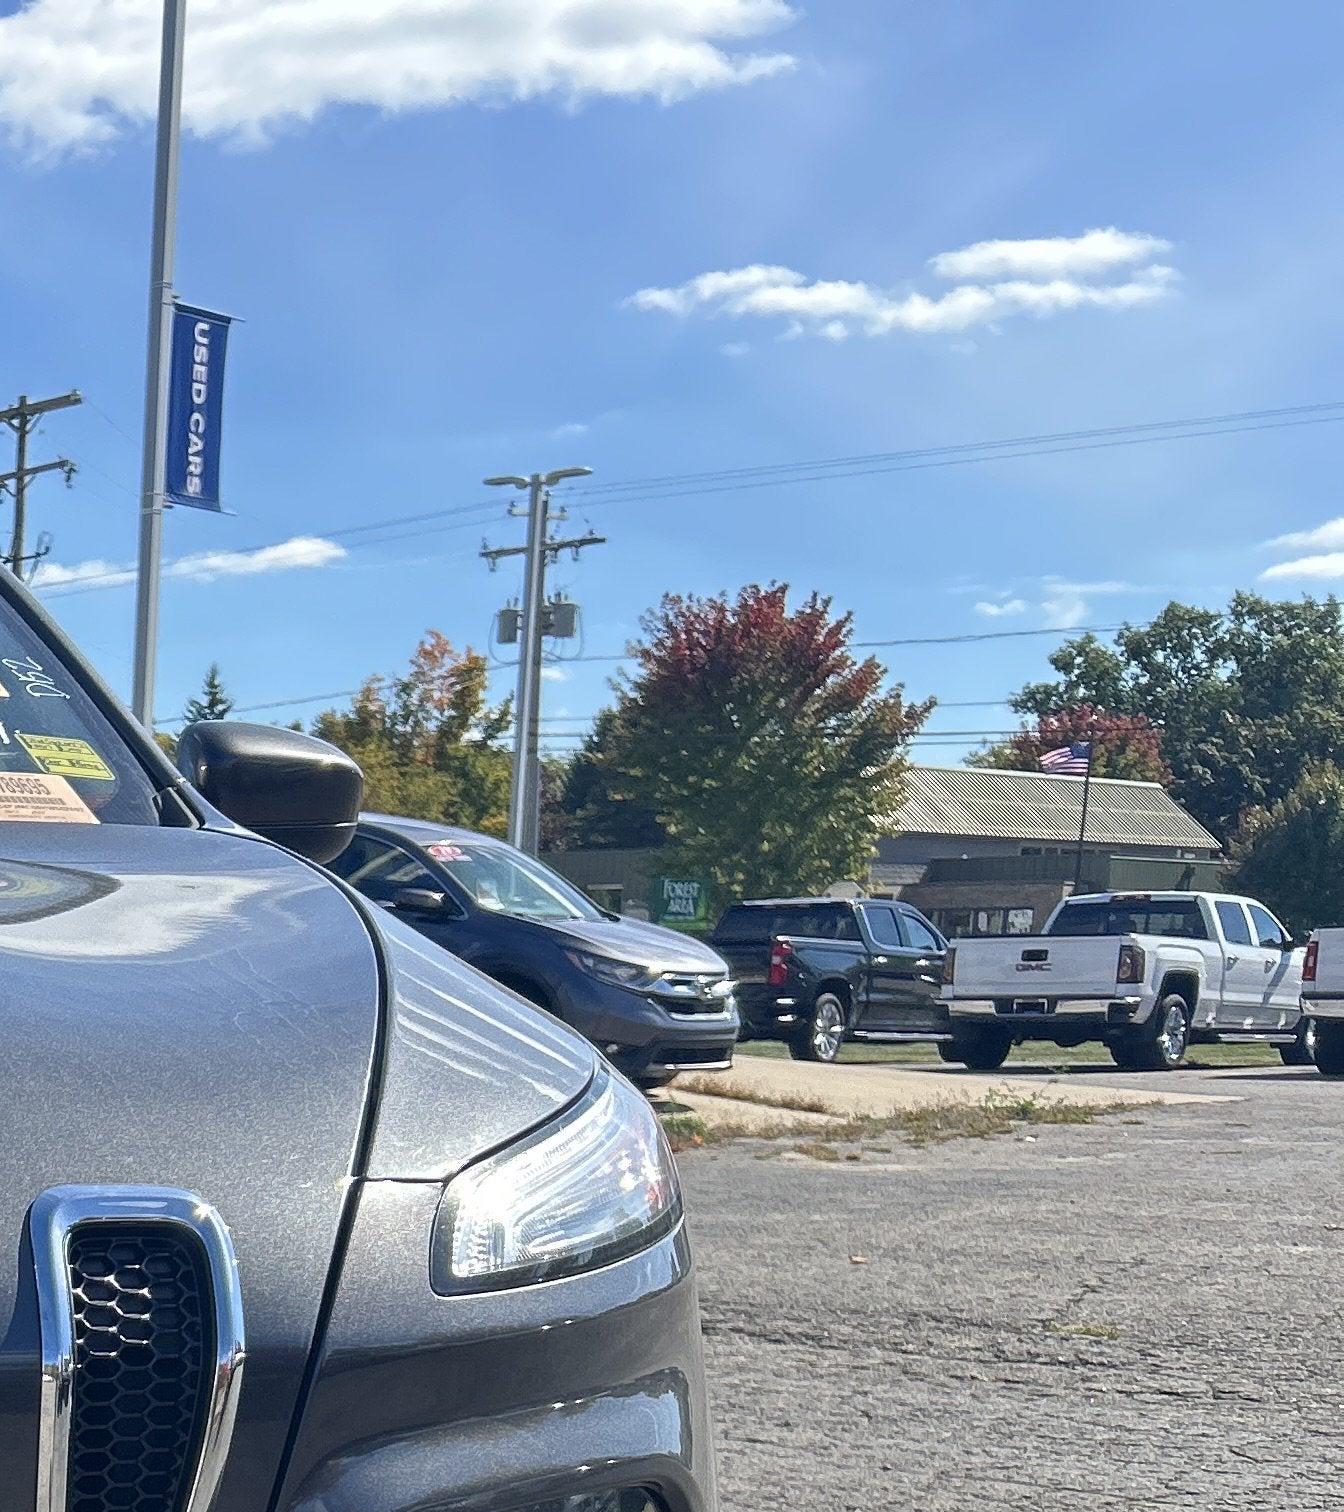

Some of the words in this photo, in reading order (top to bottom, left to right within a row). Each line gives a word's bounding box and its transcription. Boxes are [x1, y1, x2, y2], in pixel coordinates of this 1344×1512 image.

[190, 321, 211, 405] USED
[185, 412, 206, 495] CARS
[663, 879, 701, 900] FOREST
[666, 896, 695, 914] AREA
